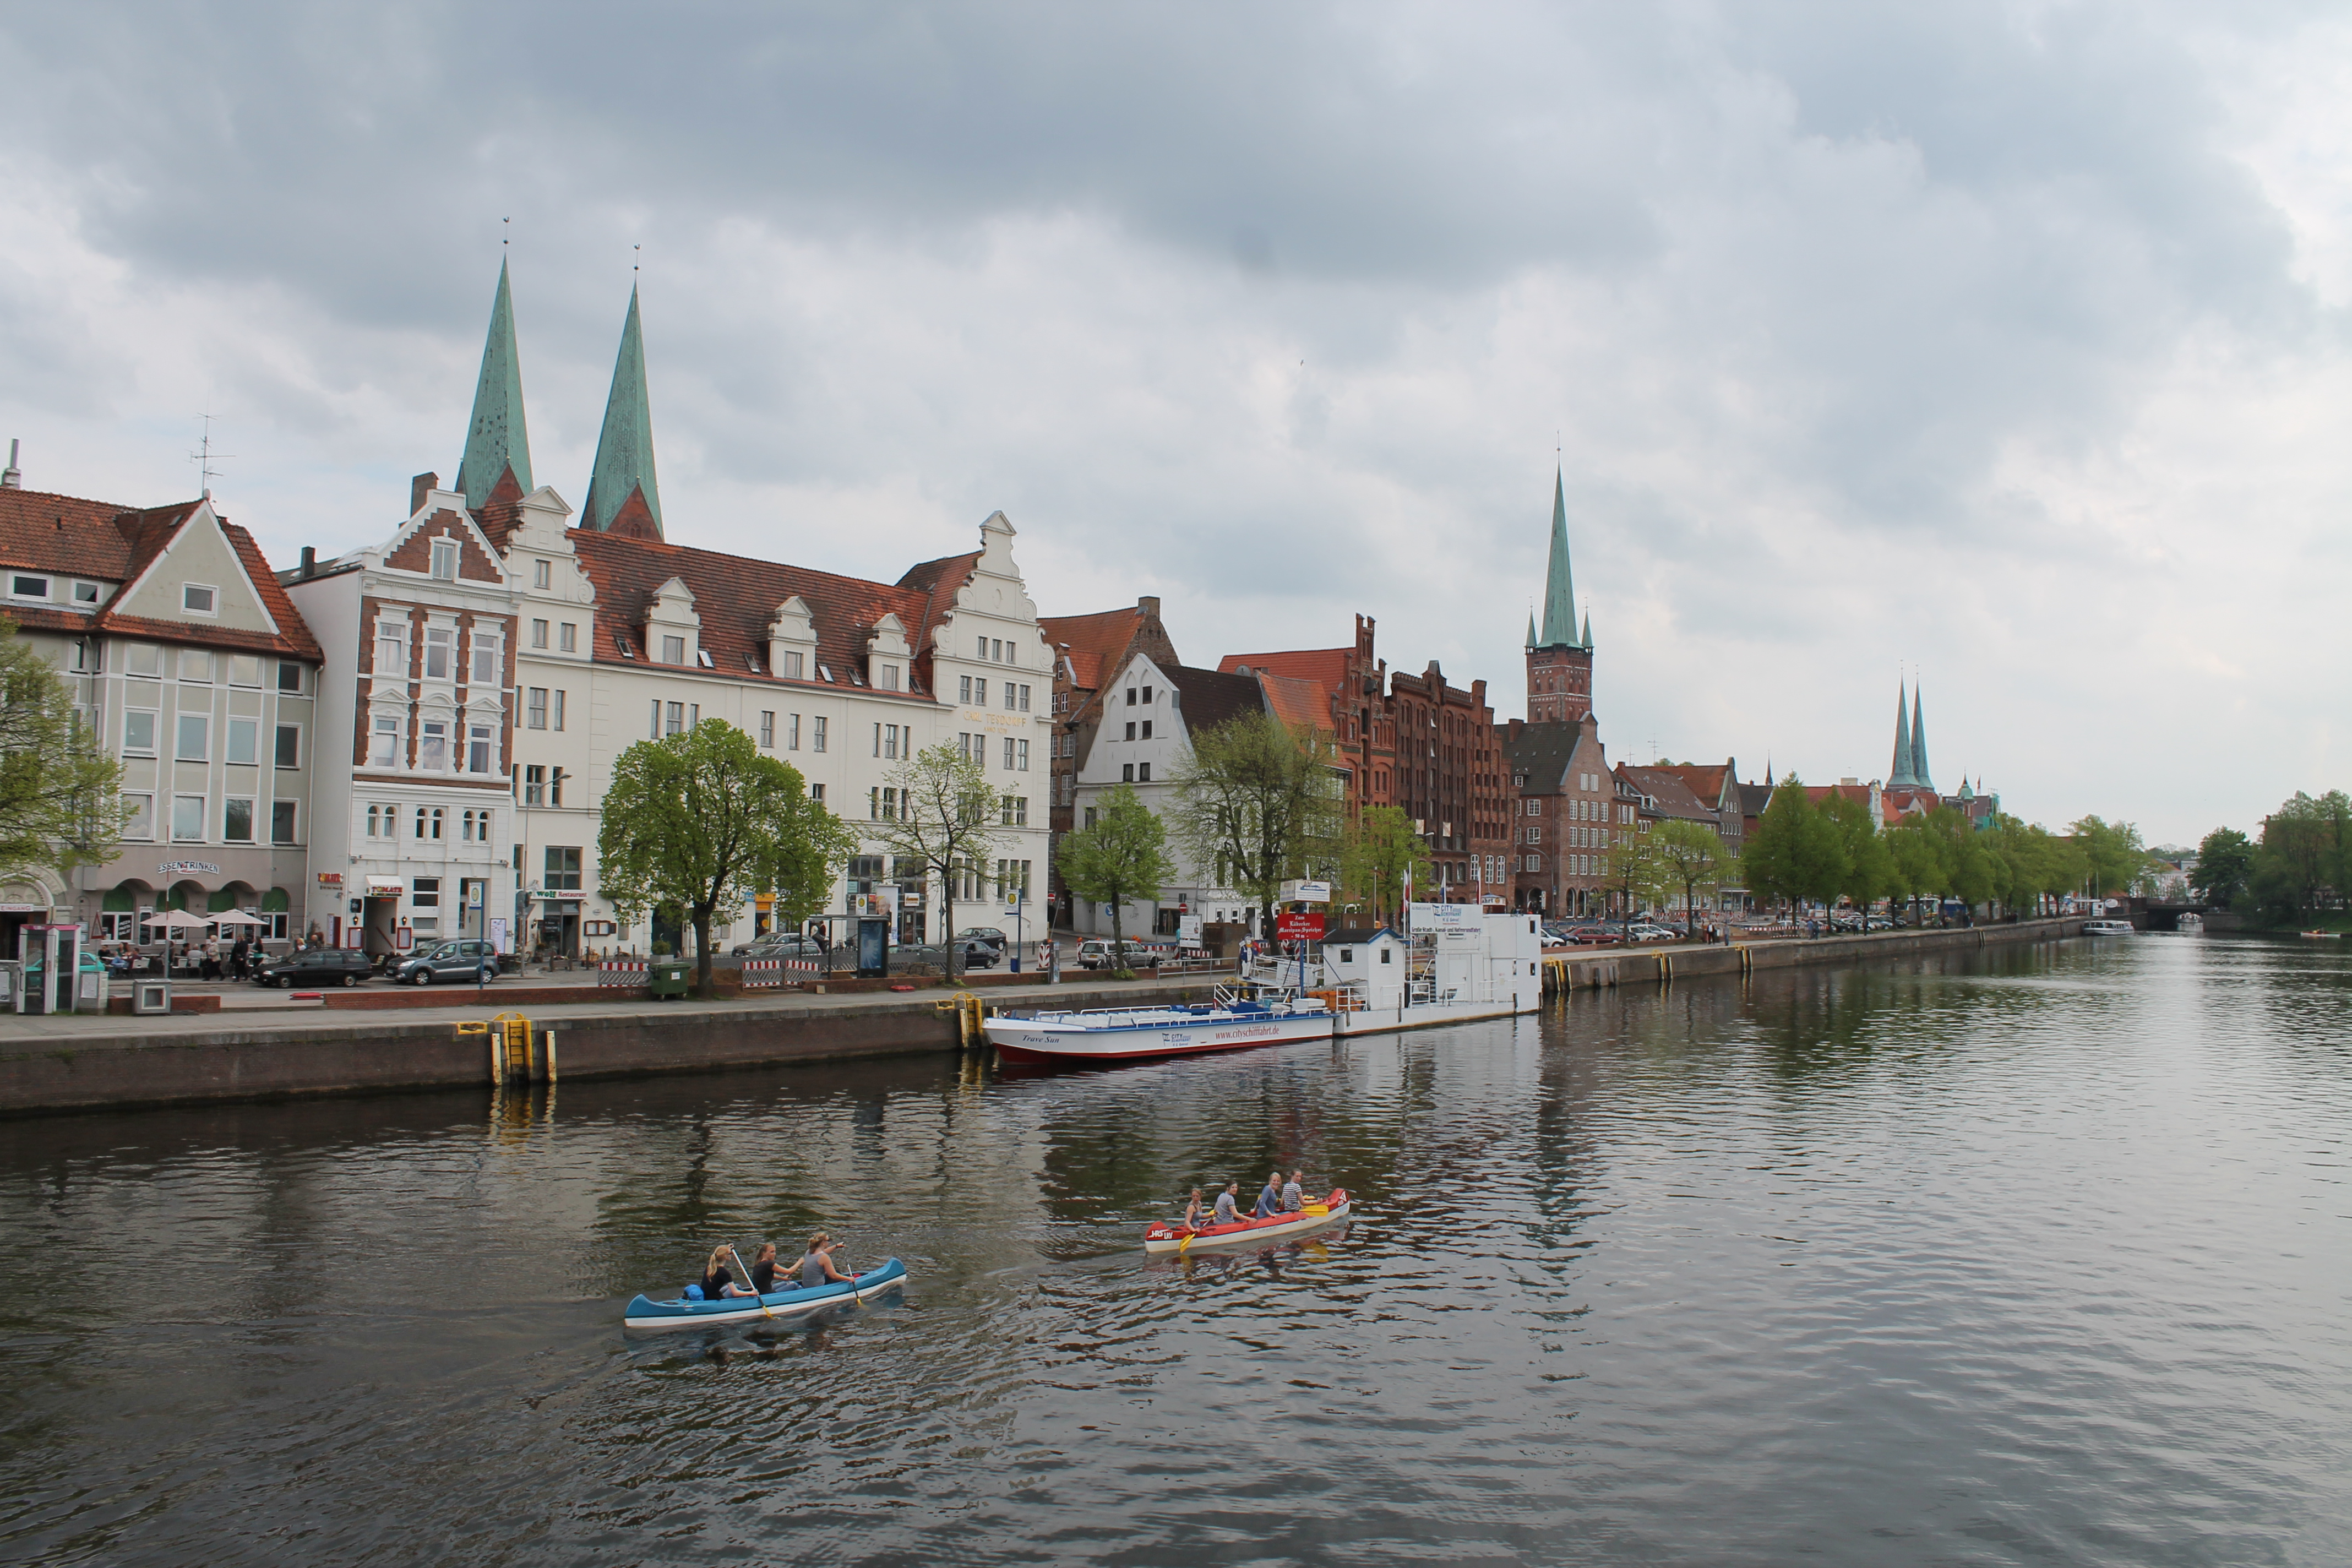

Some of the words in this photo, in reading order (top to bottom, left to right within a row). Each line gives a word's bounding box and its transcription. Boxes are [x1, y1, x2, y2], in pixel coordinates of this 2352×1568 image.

[964, 711, 982, 722] CARL
[986, 714, 1026, 727] TESDORPF
[158, 862, 182, 872] ESSEN
[184, 862, 217, 872] TRINKEN
